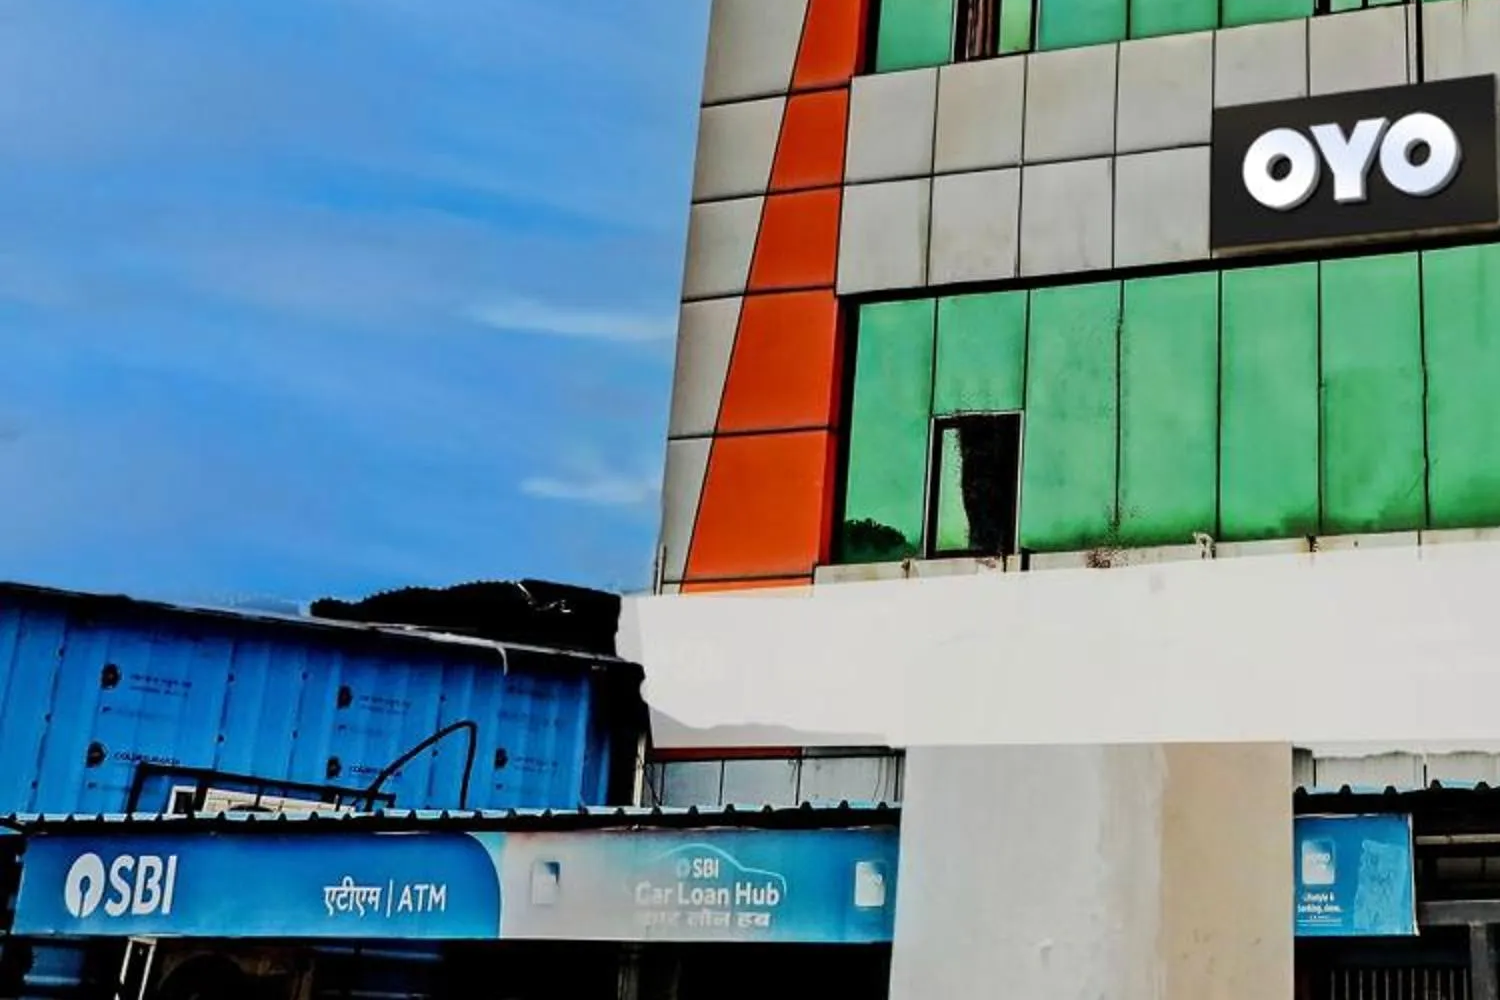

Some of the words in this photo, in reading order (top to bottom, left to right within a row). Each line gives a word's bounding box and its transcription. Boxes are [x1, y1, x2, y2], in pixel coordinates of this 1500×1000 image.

[1242, 111, 1462, 212] OYO
[105, 853, 178, 917] SBI
[692, 857, 719, 879] SBI
[323, 876, 382, 916] एटीएम
[397, 883, 447, 913] ATM
[634, 879, 673, 906] Car
[677, 881, 730, 907] Loan
[734, 881, 780, 906] Hub
